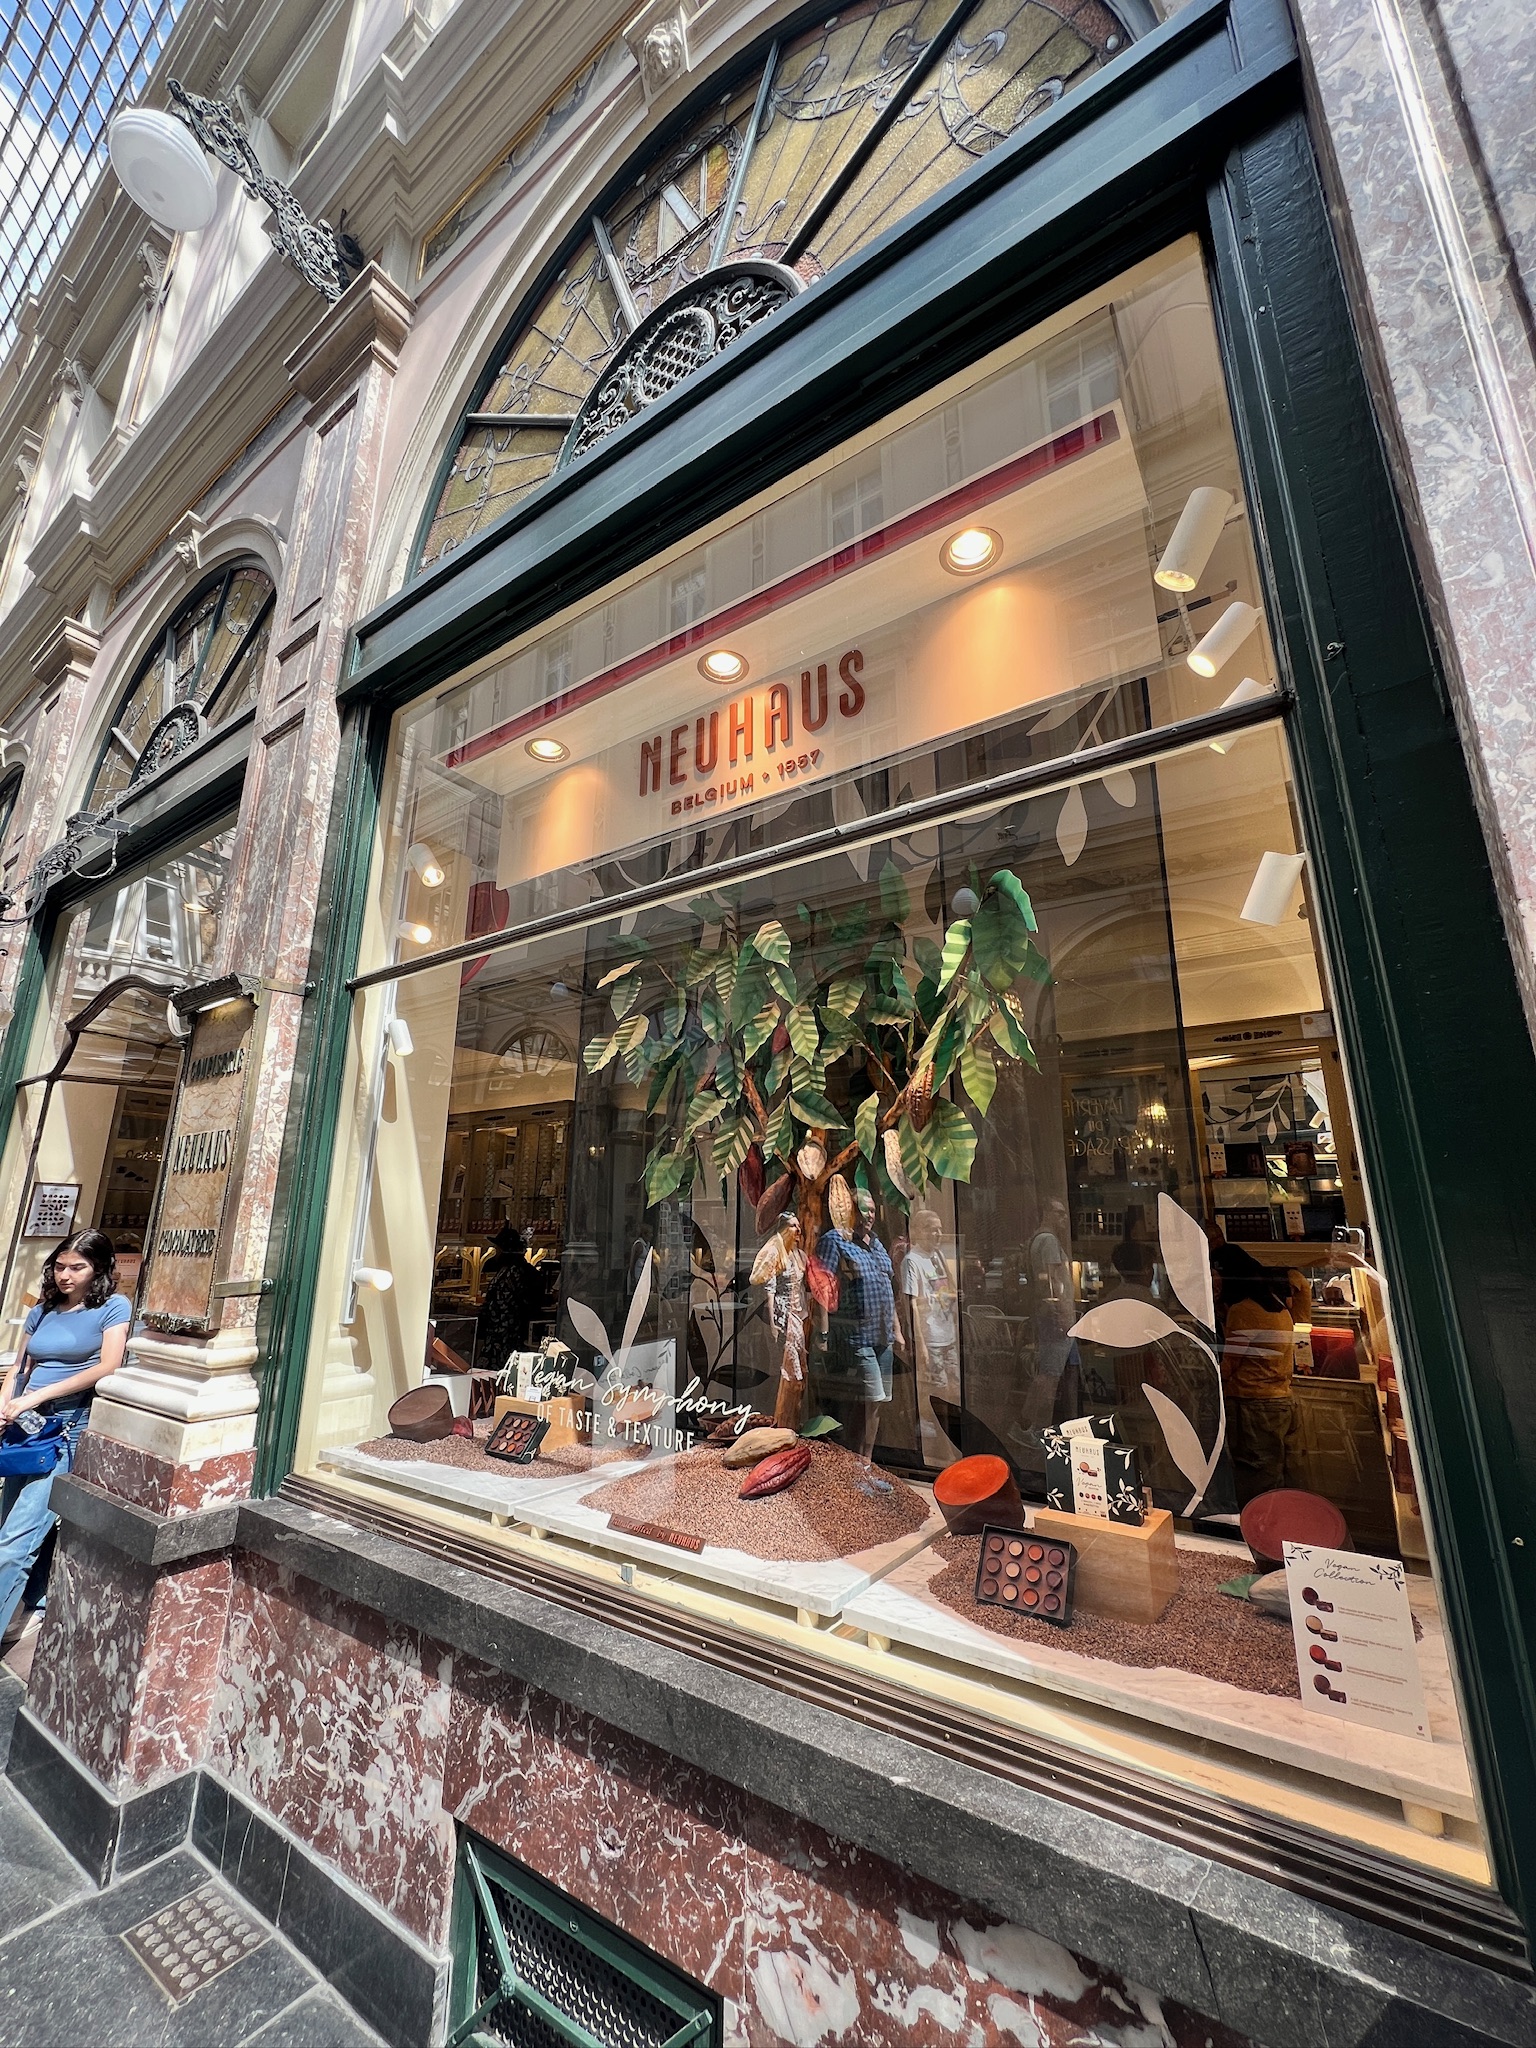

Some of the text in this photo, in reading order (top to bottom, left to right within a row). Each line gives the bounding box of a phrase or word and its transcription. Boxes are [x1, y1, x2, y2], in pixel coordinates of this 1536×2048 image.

[638, 649, 866, 798] NEUHAUS
[671, 772, 754, 816] BELGIUM
[172, 1129, 231, 1176] NEUHAUS
[495, 1350, 517, 1392] A
[601, 1366, 761, 1434] Symphony
[536, 1403, 696, 1452] OF TASTE & TEXTURE
[668, 1532, 700, 1550] NEUHAUS
[1313, 1567, 1376, 1586] Collection
[1324, 1558, 1361, 1572] Vegan
